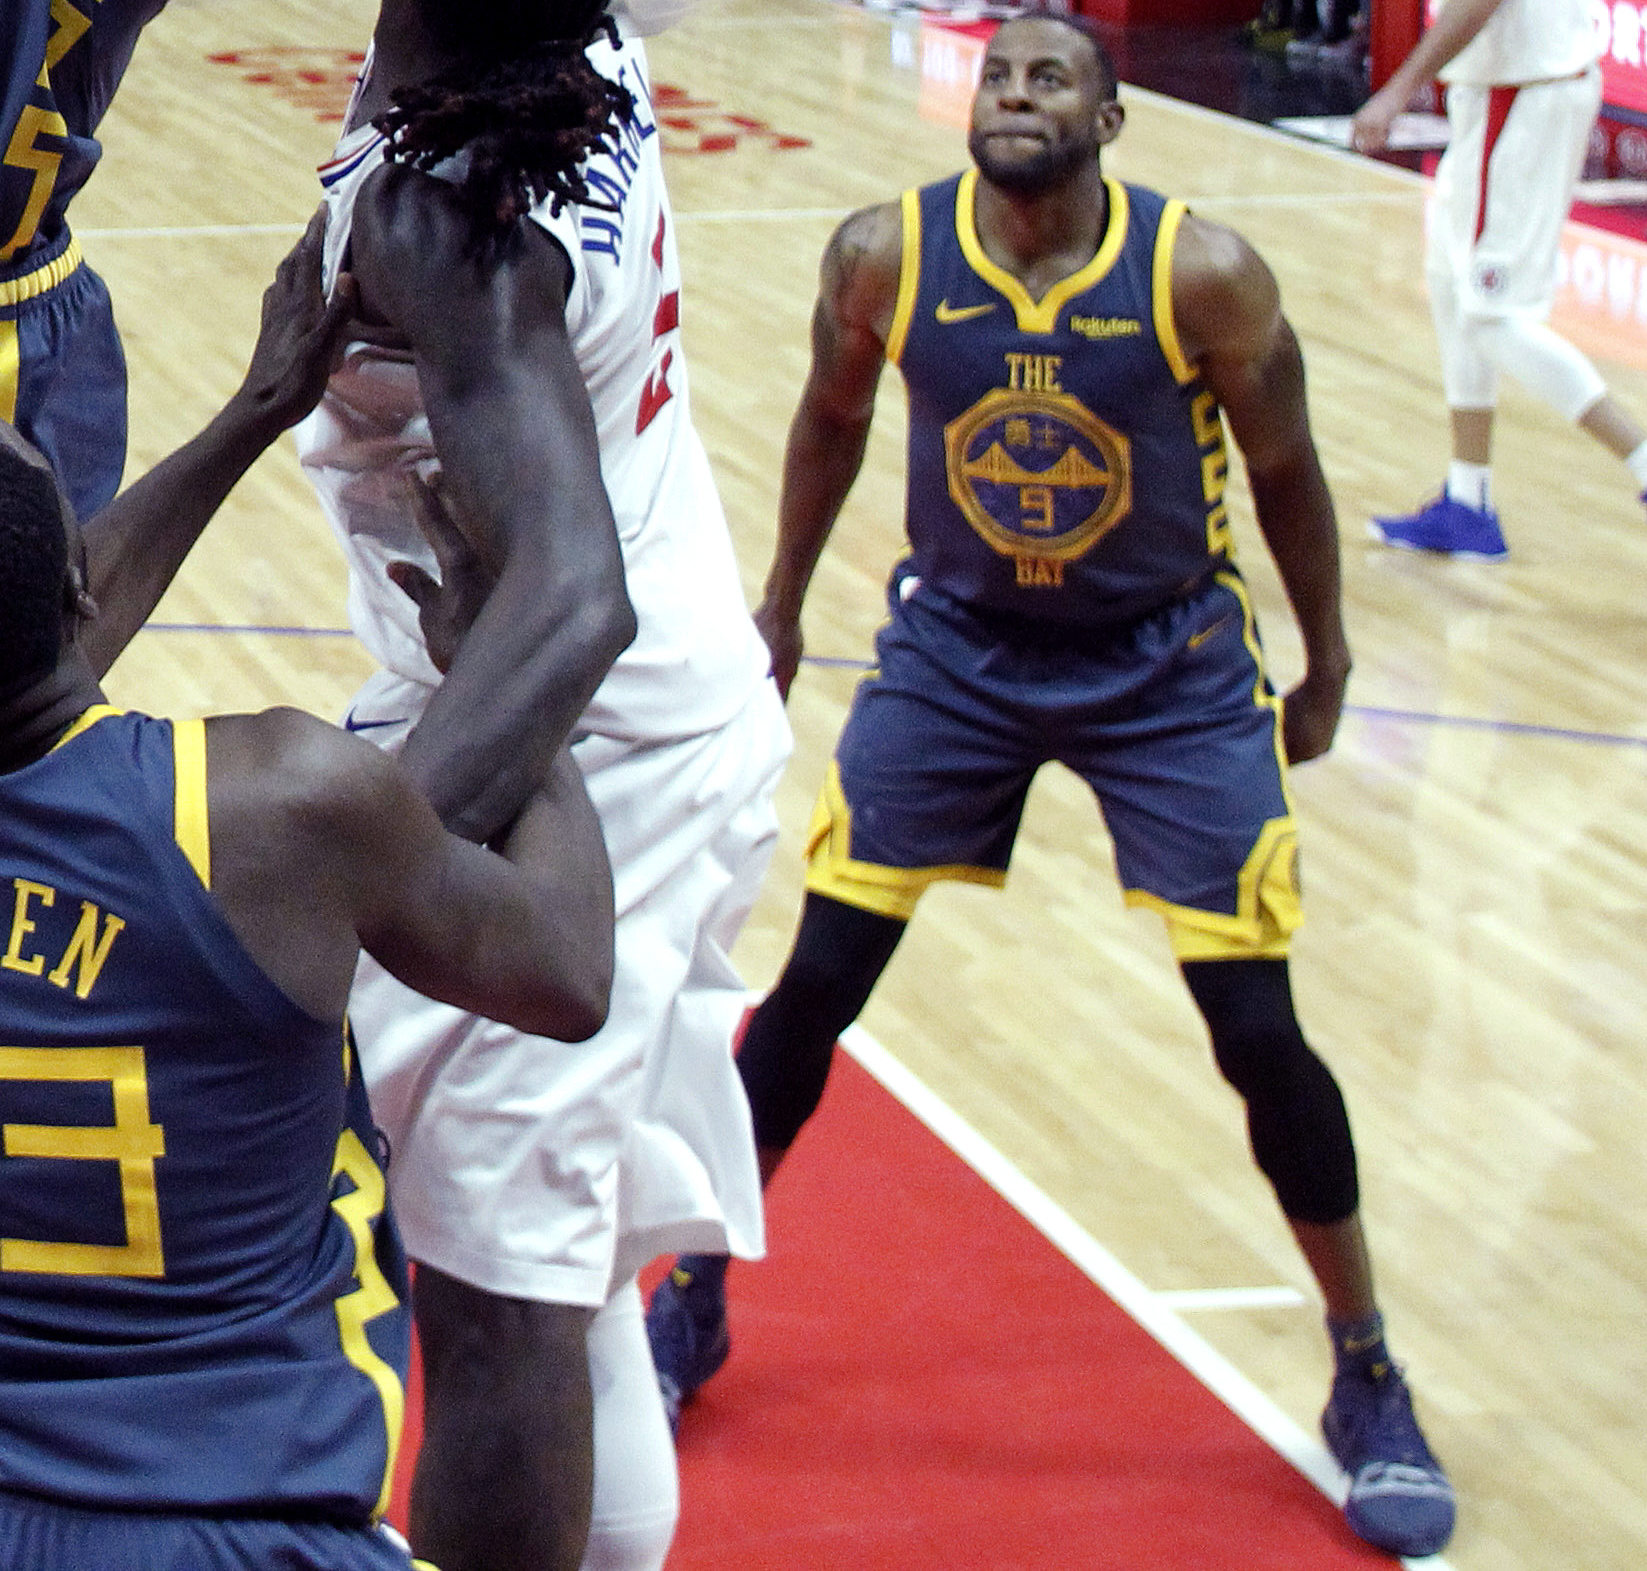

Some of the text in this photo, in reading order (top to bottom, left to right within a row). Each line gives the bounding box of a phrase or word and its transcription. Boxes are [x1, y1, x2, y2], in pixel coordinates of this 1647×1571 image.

[1004, 352, 1063, 392] THE
[1019, 485, 1055, 530] 9
[1016, 557, 1065, 589] BAY
